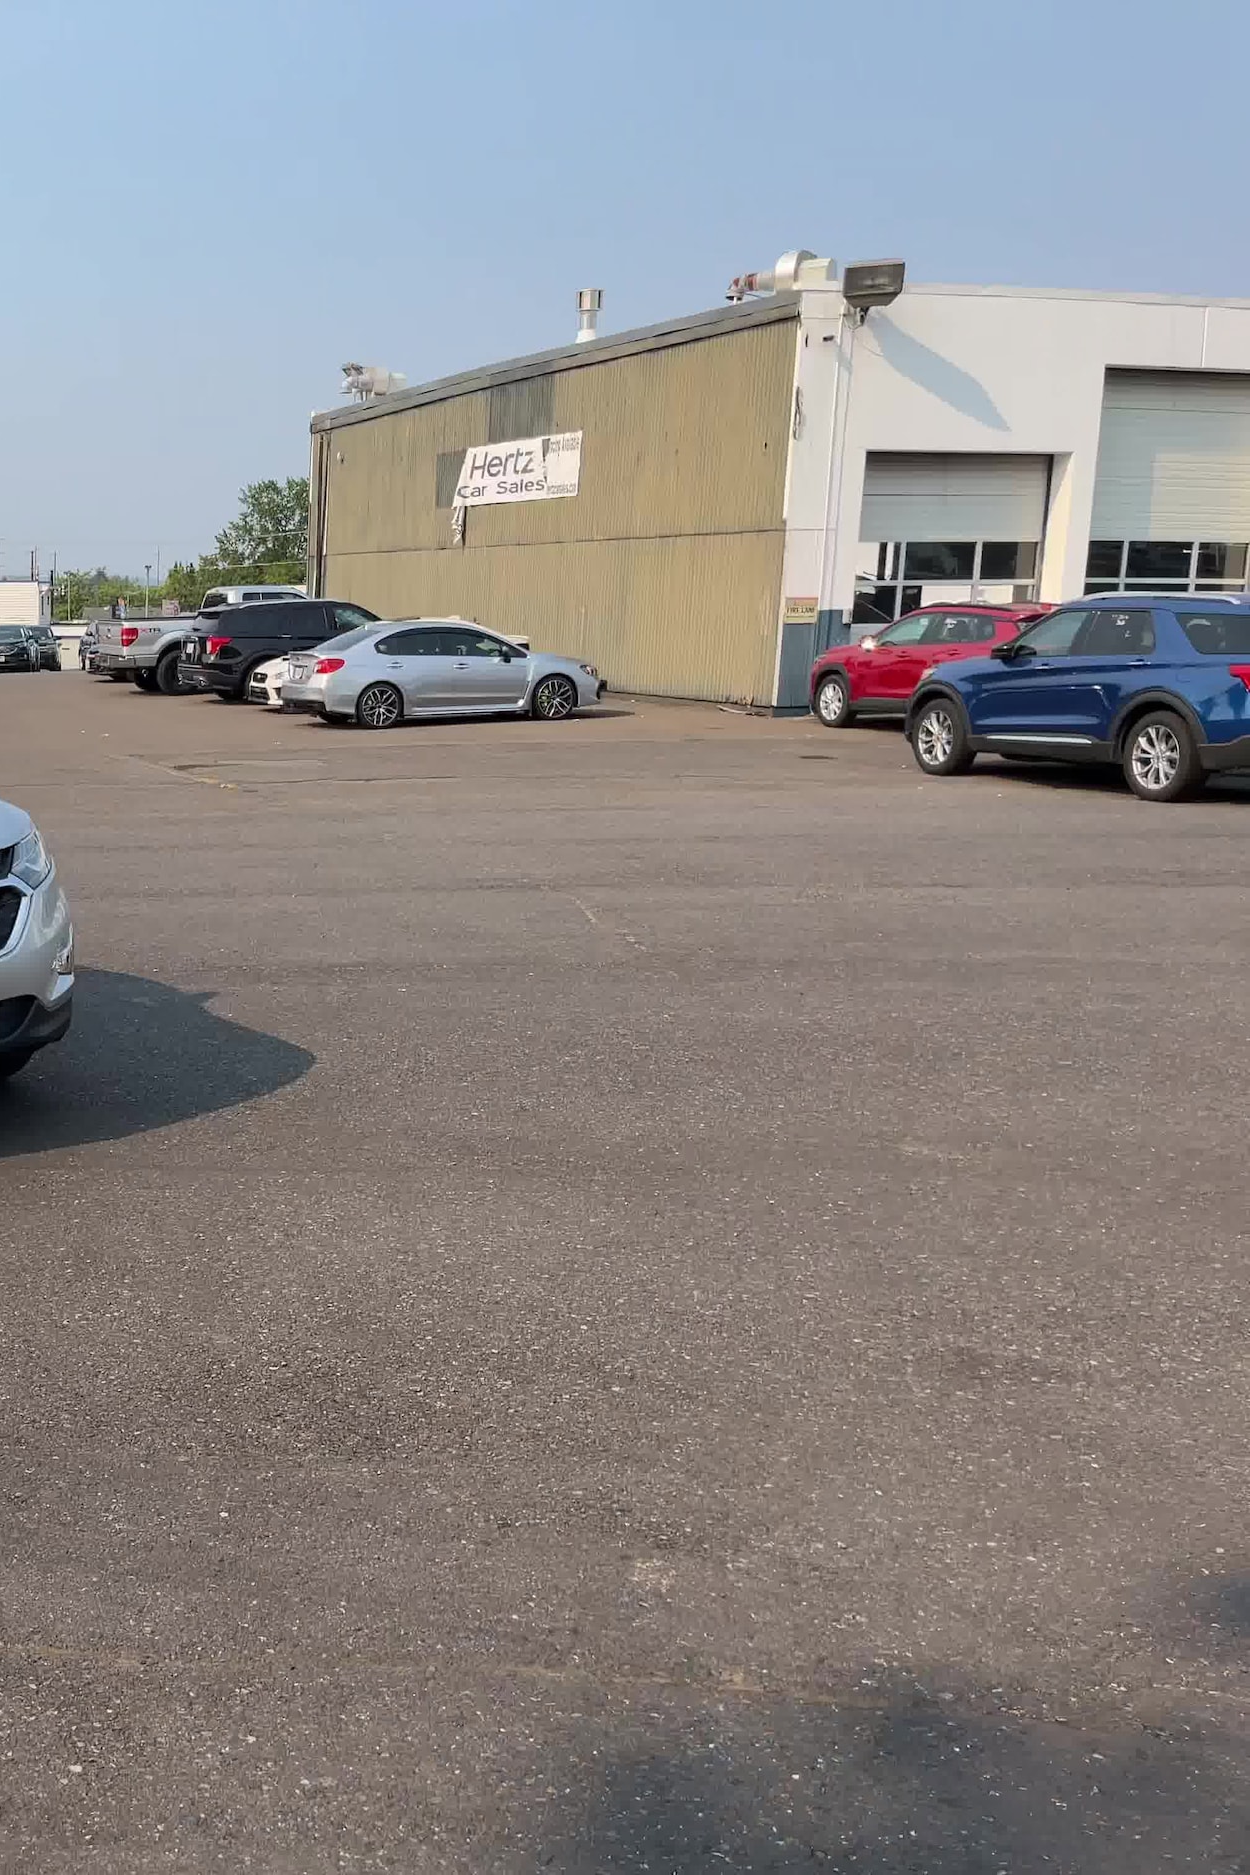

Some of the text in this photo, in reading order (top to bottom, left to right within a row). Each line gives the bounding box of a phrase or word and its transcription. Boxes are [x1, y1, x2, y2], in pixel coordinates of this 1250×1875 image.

[469, 448, 534, 479] Hertz
[457, 485, 488, 499] Car
[496, 479, 545, 495] Sales
